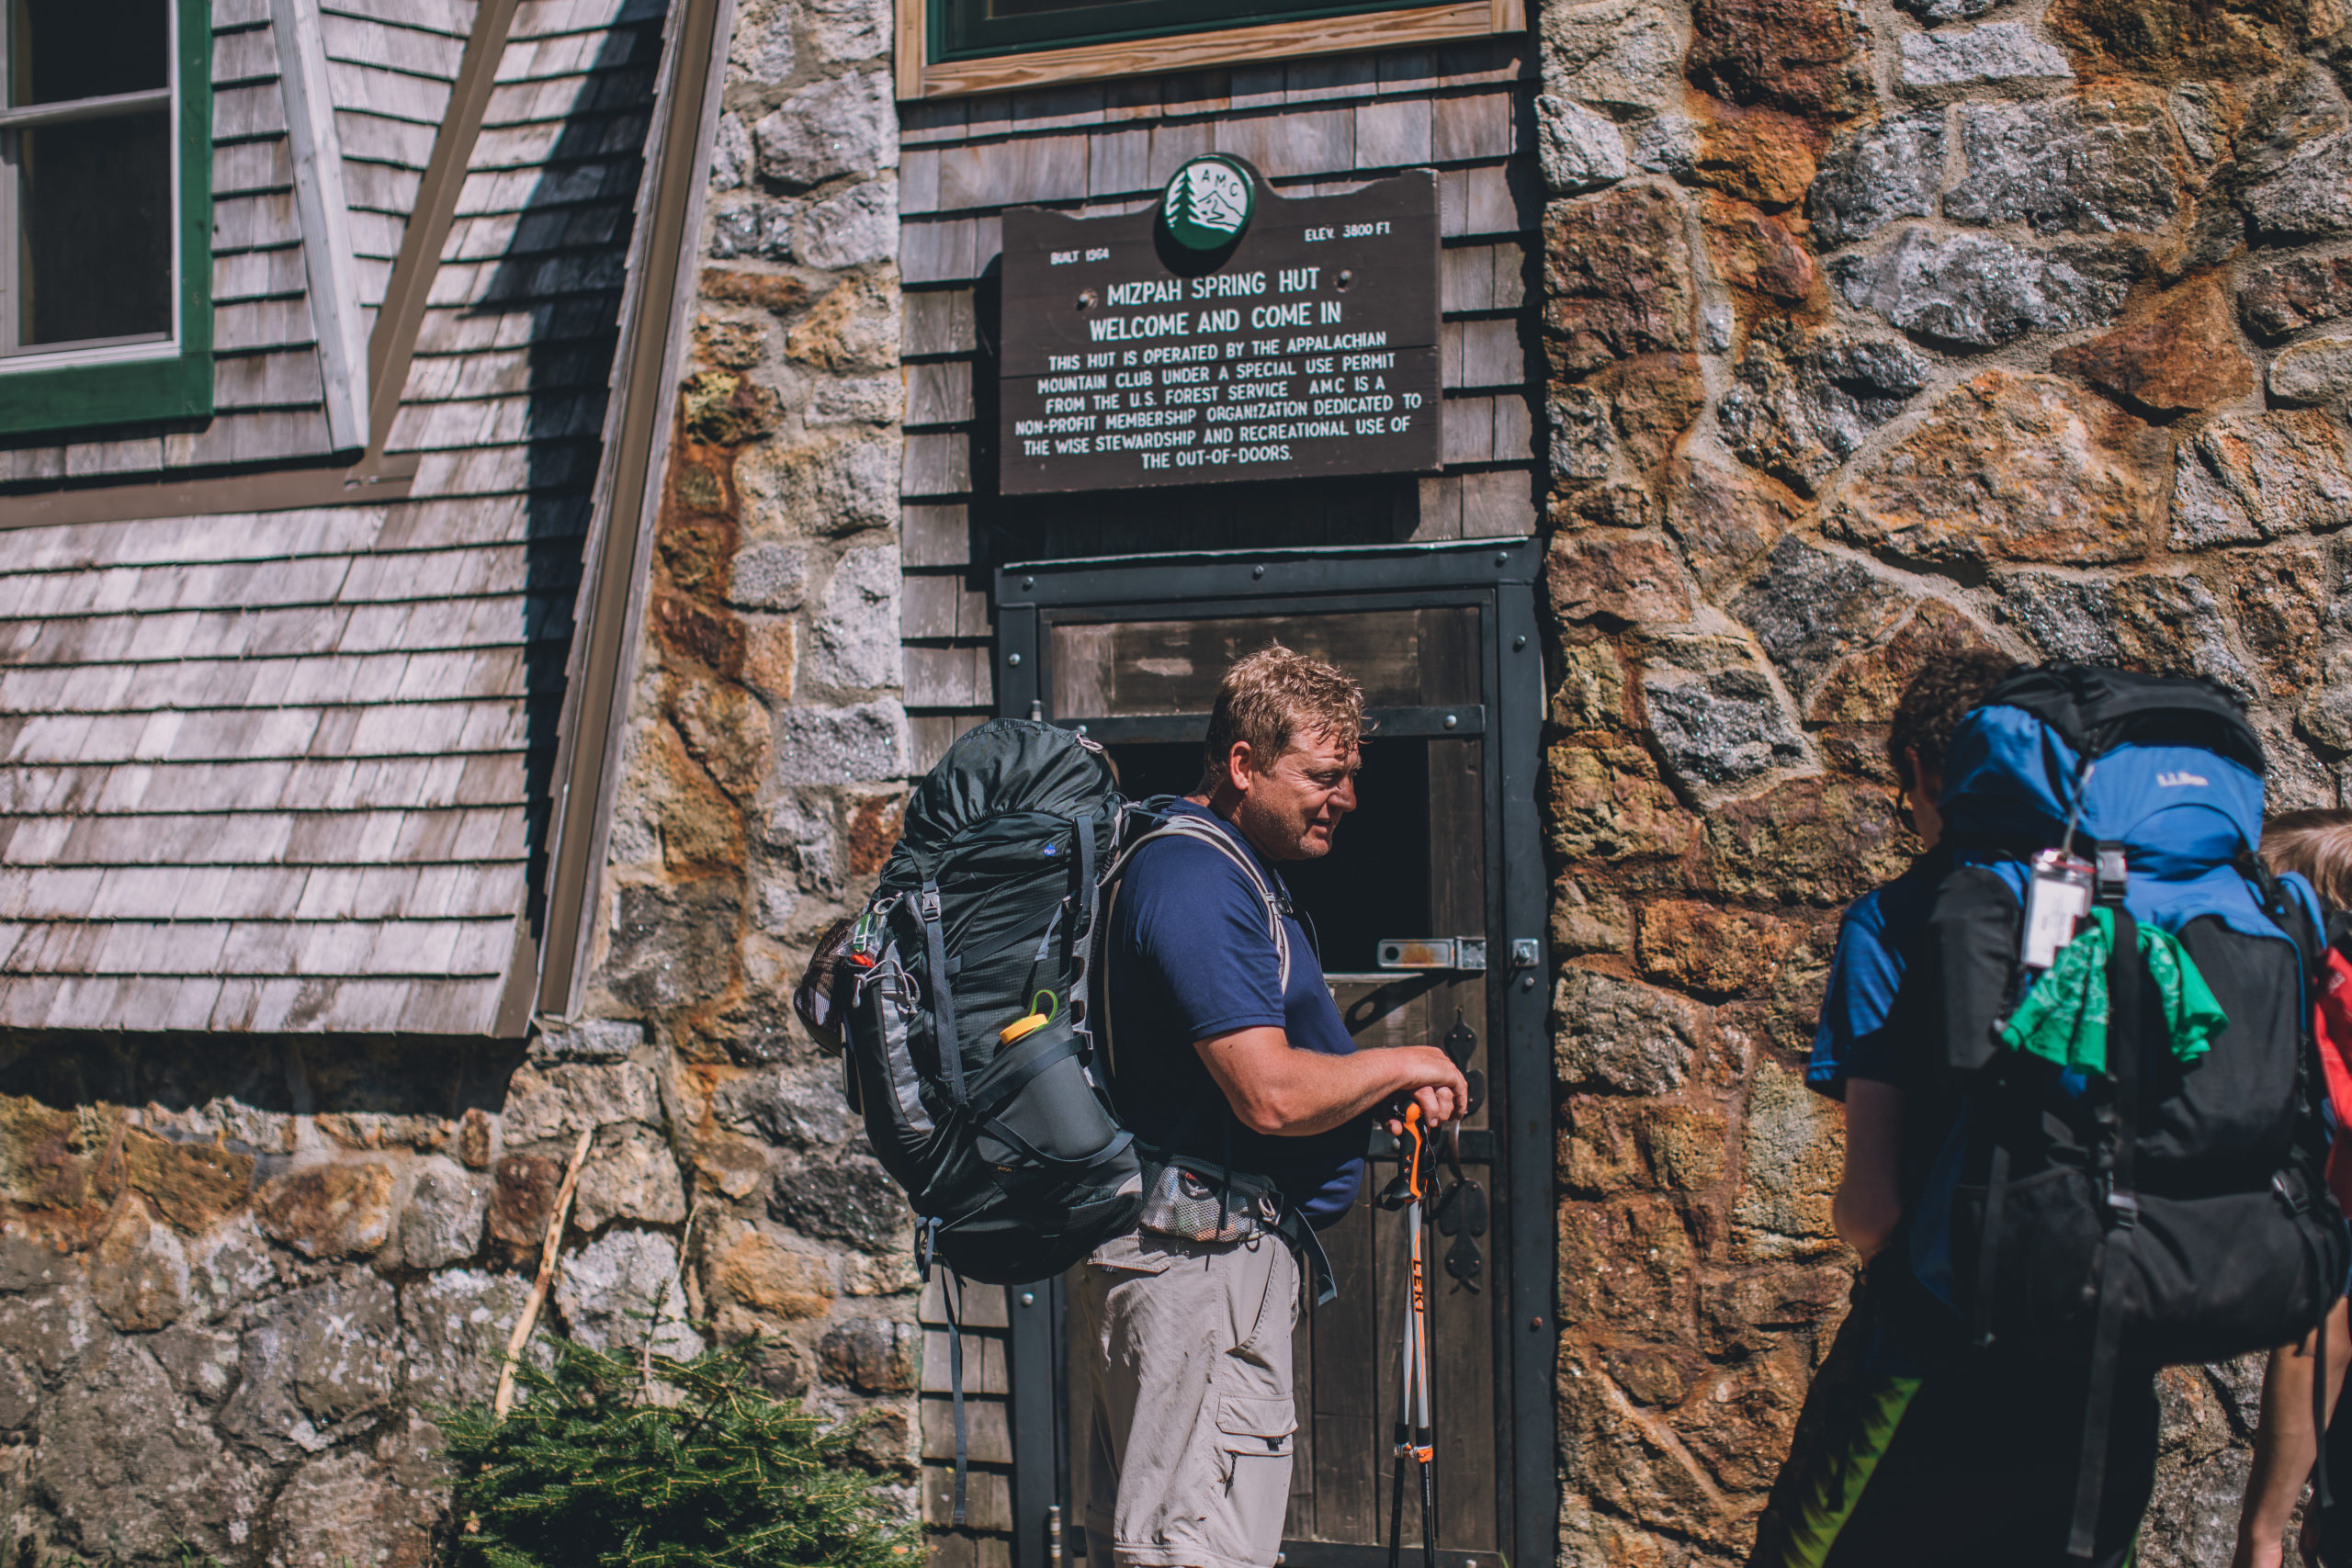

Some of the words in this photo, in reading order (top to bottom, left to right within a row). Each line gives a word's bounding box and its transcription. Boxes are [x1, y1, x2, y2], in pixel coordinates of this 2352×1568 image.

[1343, 222, 1374, 237] 3800
[1051, 250, 1080, 265] BUILT
[1107, 279, 1182, 307] MIZPAH
[1192, 271, 1265, 299] SPRING
[1279, 266, 1319, 292] HUT
[1090, 312, 1189, 341] WELCOME
[1197, 309, 1239, 333] AND
[1251, 302, 1311, 328] COME
[1320, 301, 1341, 324] IN
[1048, 354, 1080, 371] THIS
[1088, 352, 1115, 368] HUT
[1124, 350, 1137, 366] IS
[1144, 344, 1217, 364] OPERATED
[1226, 342, 1244, 358] BY
[1251, 339, 1280, 355] THE
[1286, 331, 1386, 354] APPALACHIAN
[1037, 375, 1107, 394] MOUNTAIN
[1115, 371, 1153, 389] CLUB
[1162, 367, 1210, 386] UNDER
[1218, 366, 1228, 381] A
[1236, 361, 1296, 379] SPECIAL
[1305, 357, 1334, 375] USE
[1342, 352, 1395, 372] PERMIT
[1015, 415, 1096, 436] NON-PROFIT
[1105, 409, 1196, 430] MEMBERSHIP
[1206, 401, 1307, 423] ORGANIZATION
[1314, 393, 1394, 416] DEDICATED
[1403, 392, 1421, 409] TO
[1046, 397, 1085, 414] FROM
[1092, 394, 1120, 411] THE
[1129, 391, 1158, 408] U.S.
[1165, 387, 1218, 405] FOREST
[1227, 381, 1288, 400] SERVICE
[1309, 378, 1345, 395] AMC
[1354, 376, 1369, 391] IS
[1374, 375, 1385, 390] A
[1023, 439, 1051, 457] THE
[1056, 436, 1090, 454] WISE
[1096, 430, 1196, 452] STEWARDSHIP
[1204, 427, 1233, 445] AND
[1239, 420, 1349, 442] RECREATIONAL
[1355, 419, 1385, 435] USE
[1391, 415, 1411, 433] OF
[1142, 452, 1170, 469] THE
[1176, 445, 1293, 468] OUT-OF-DOORS.
[1412, 1258, 1424, 1314] LEKI
